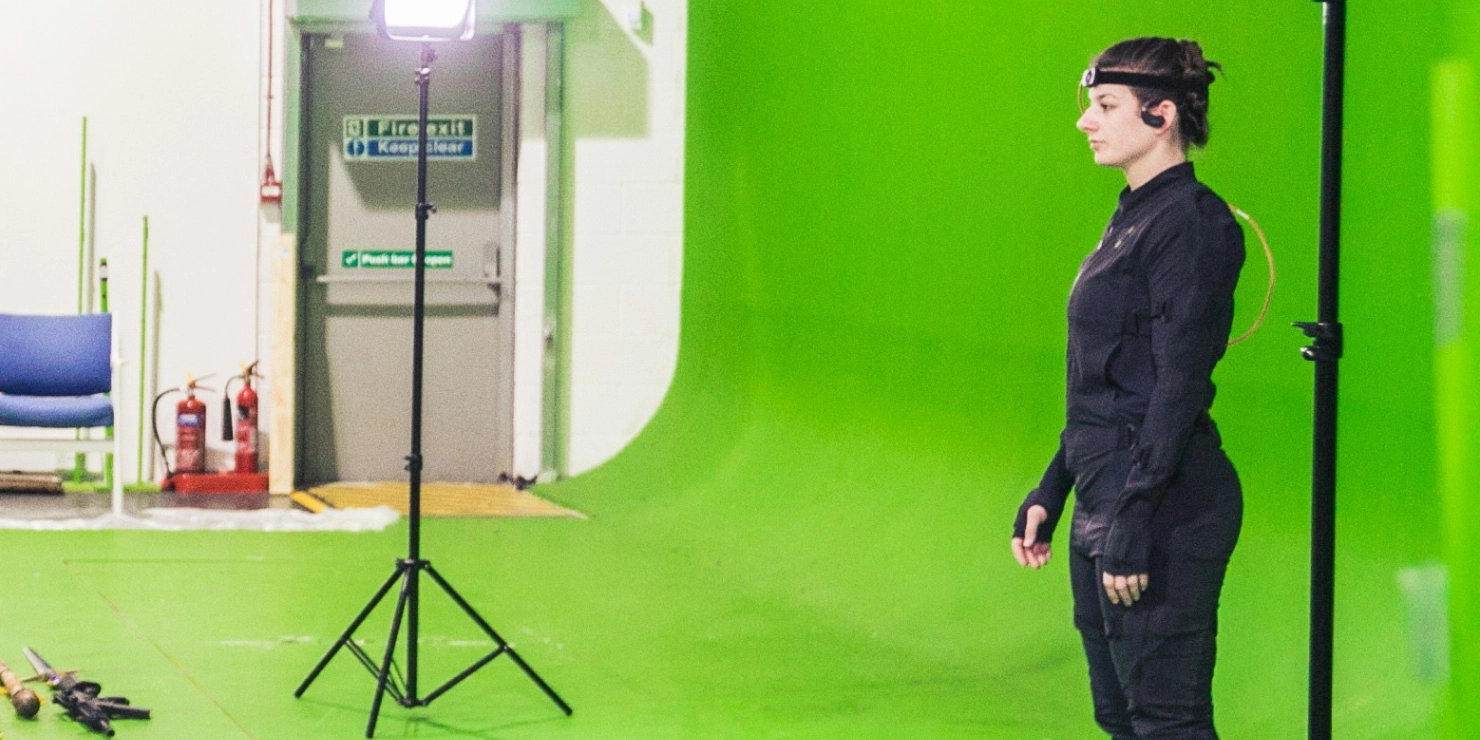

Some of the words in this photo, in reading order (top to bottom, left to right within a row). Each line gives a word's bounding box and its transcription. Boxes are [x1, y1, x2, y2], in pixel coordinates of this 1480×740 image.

[378, 119, 419, 136] Fire
[426, 119, 465, 136] exit
[378, 140, 419, 155] Keep
[425, 139, 464, 154] clear
[361, 253, 389, 265] Push
